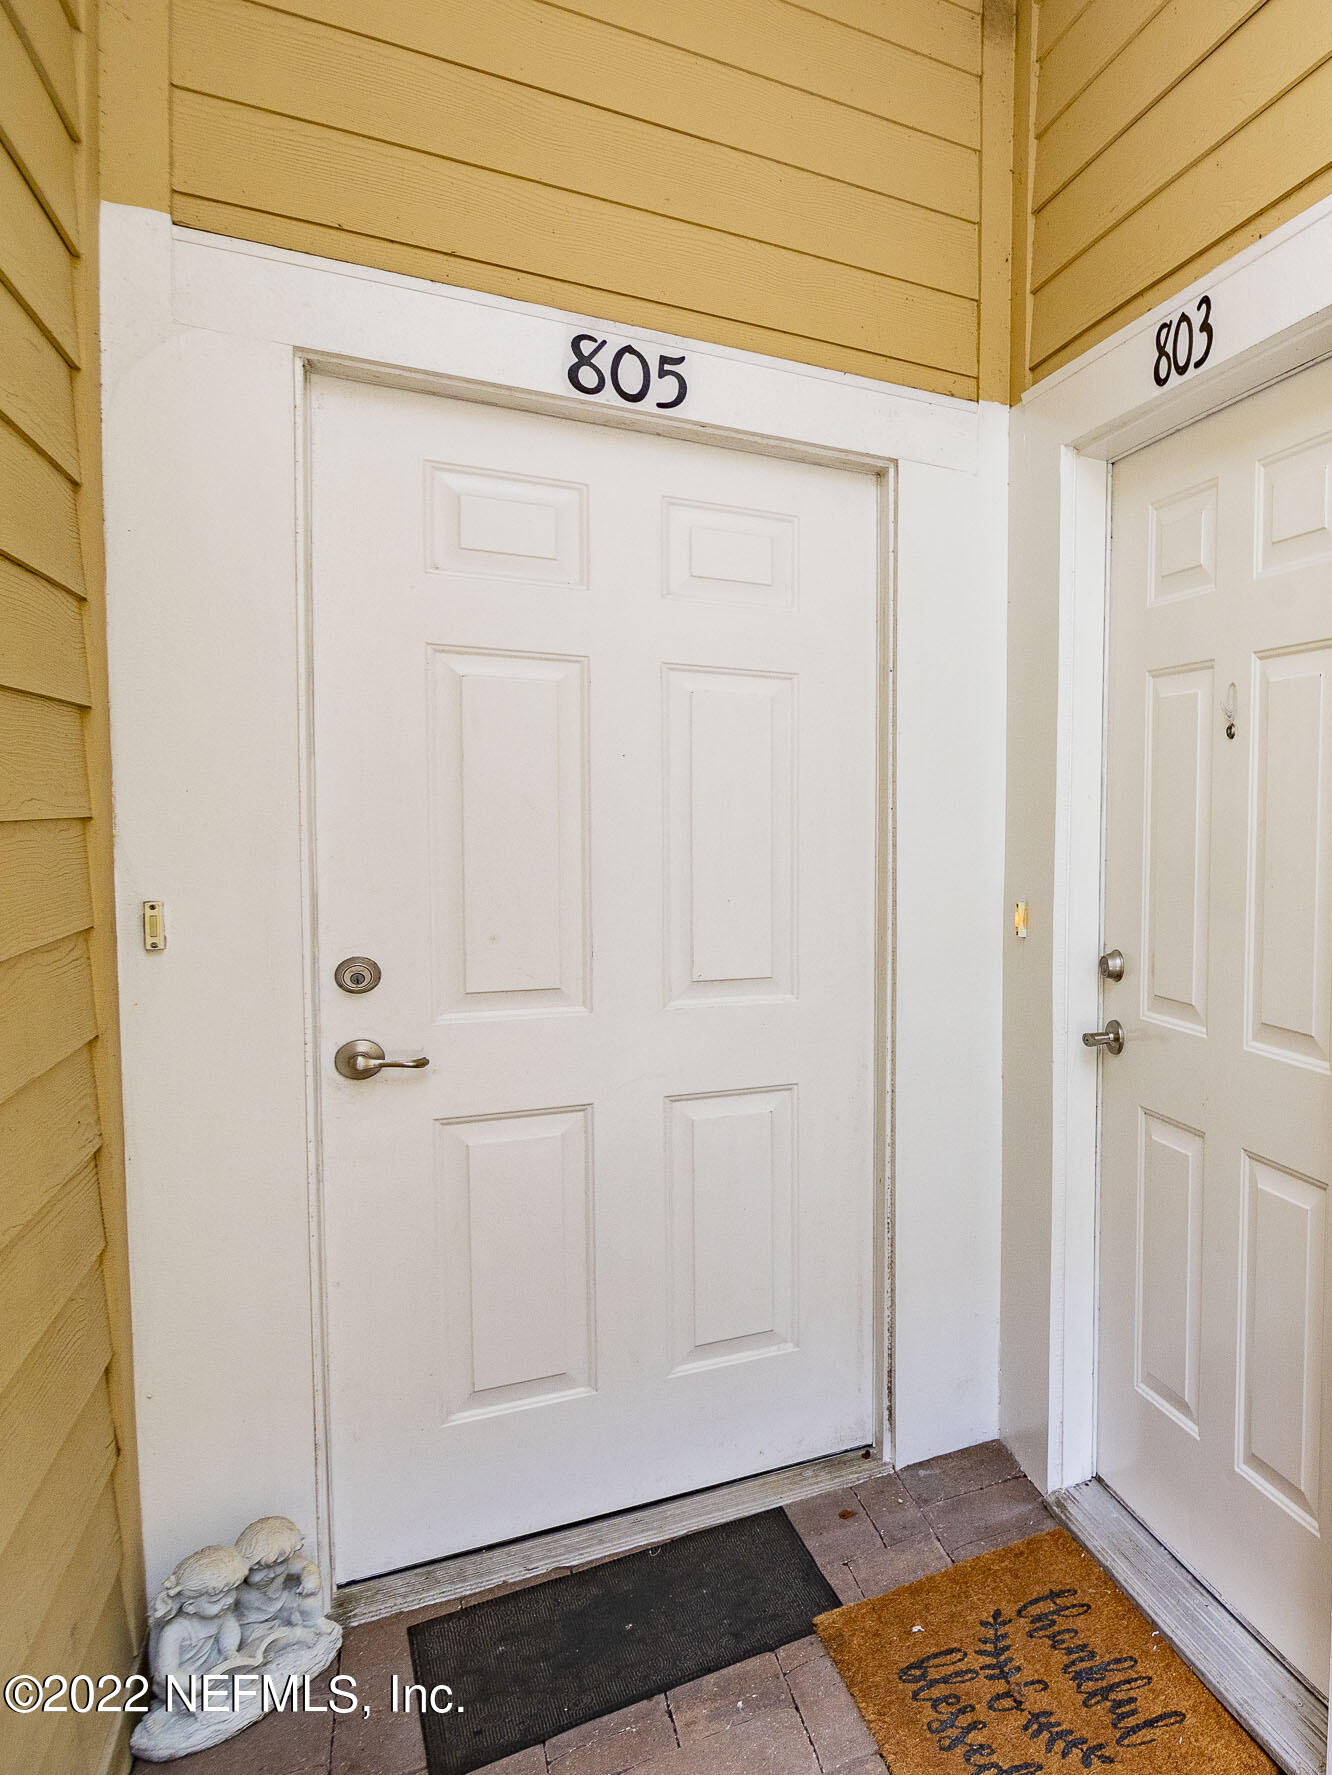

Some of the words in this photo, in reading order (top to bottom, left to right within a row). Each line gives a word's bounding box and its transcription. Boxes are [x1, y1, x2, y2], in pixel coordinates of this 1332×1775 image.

[567, 333, 688, 409] 805
[1152, 295, 1214, 387] 803
[1015, 1588, 1187, 1748] thankful
